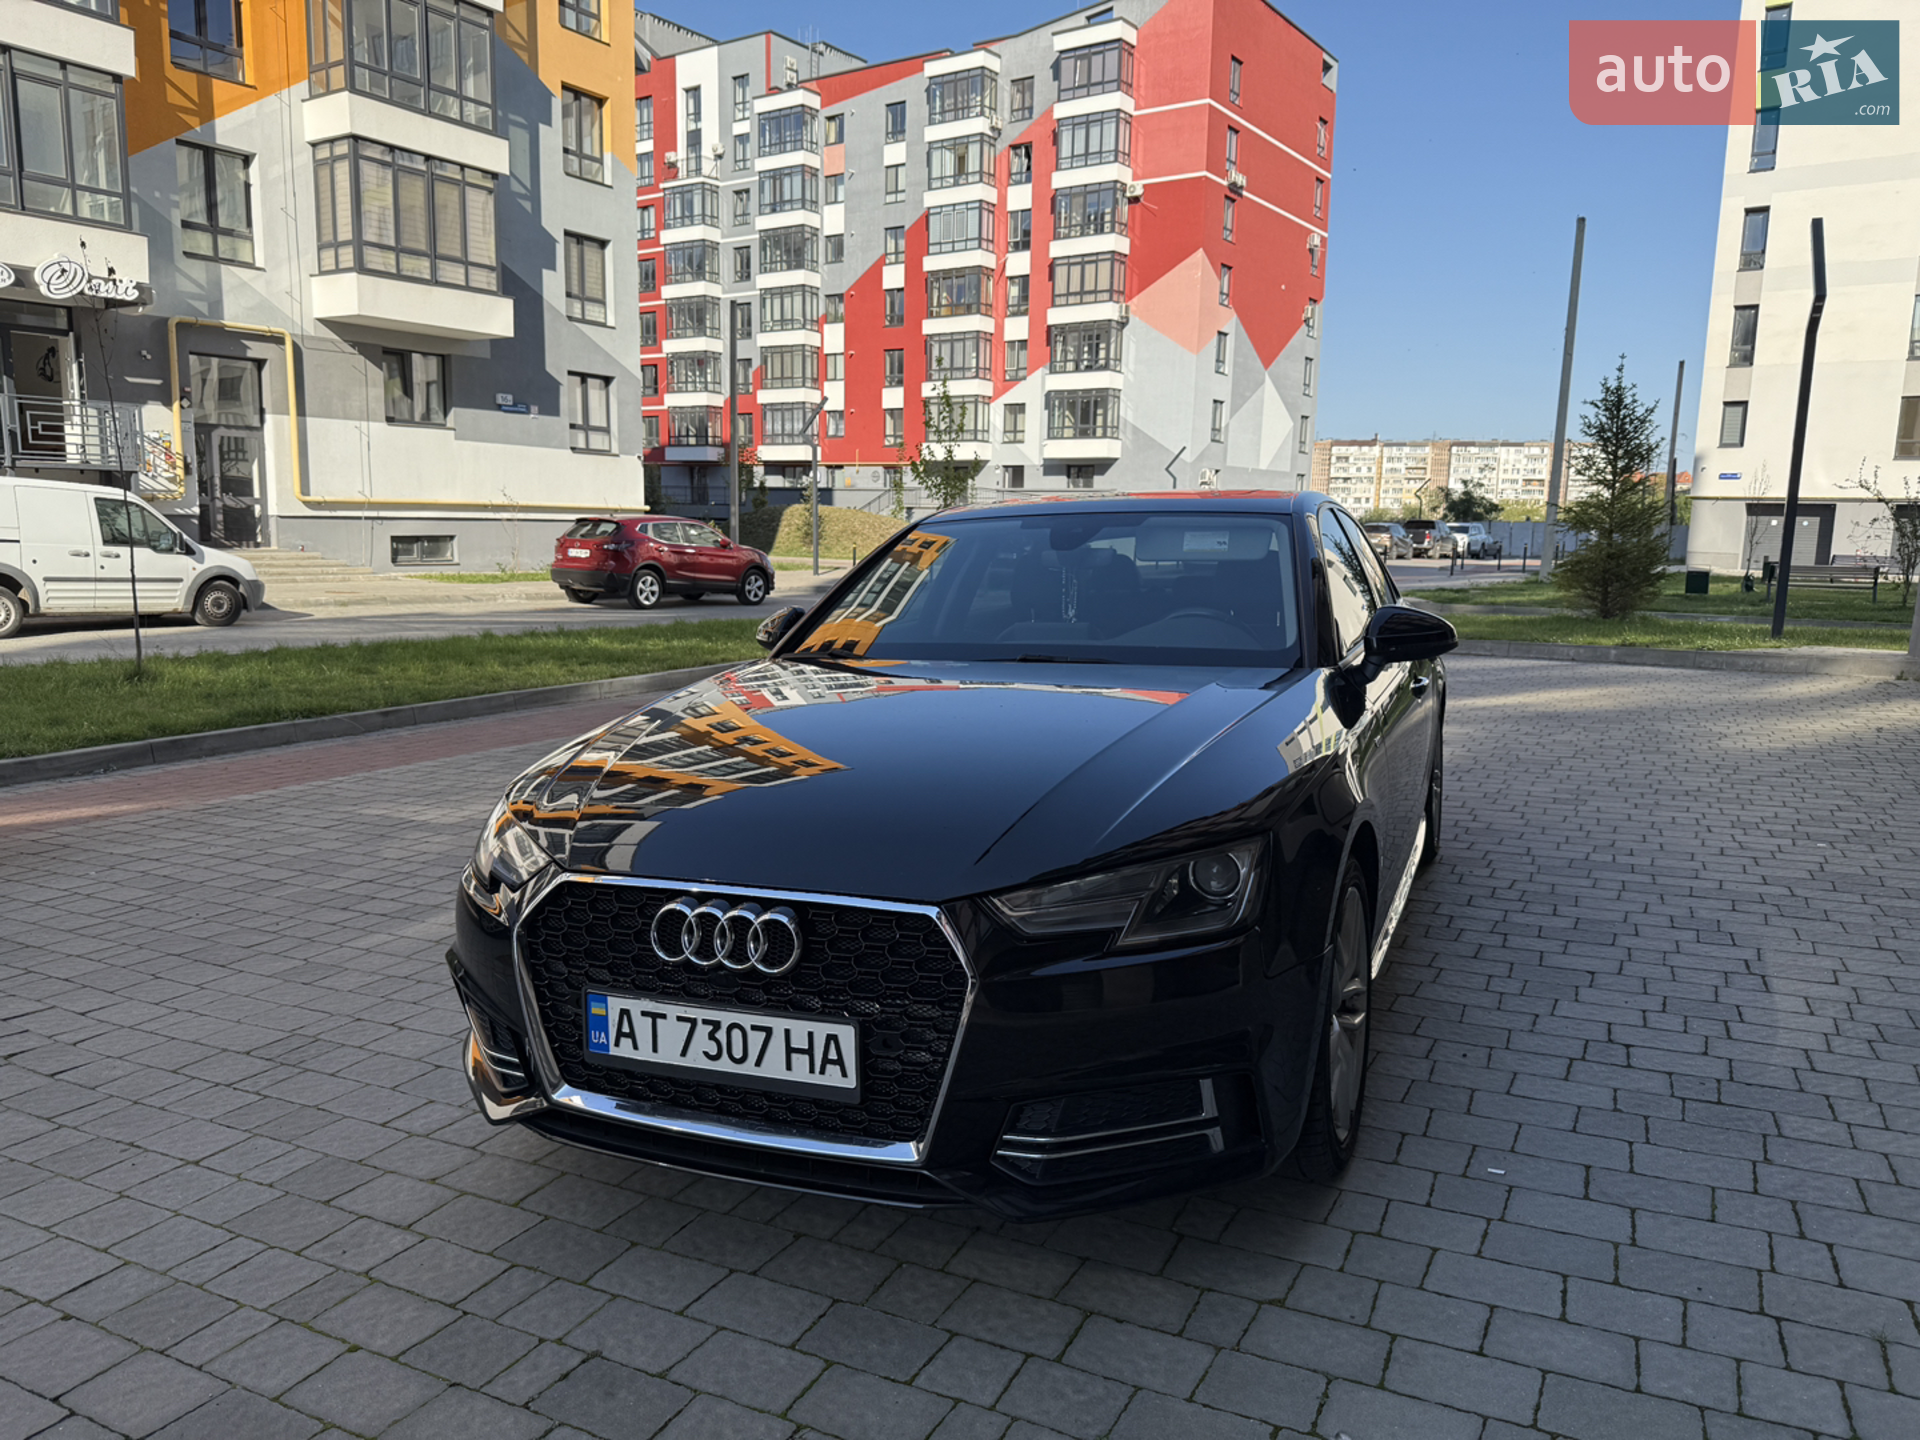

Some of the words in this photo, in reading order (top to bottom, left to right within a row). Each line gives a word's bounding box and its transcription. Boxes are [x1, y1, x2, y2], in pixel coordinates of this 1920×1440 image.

[591, 1030, 608, 1046] UA
[614, 1007, 668, 1054] AT
[676, 1015, 773, 1068] 7307
[784, 1028, 849, 1078] HA
